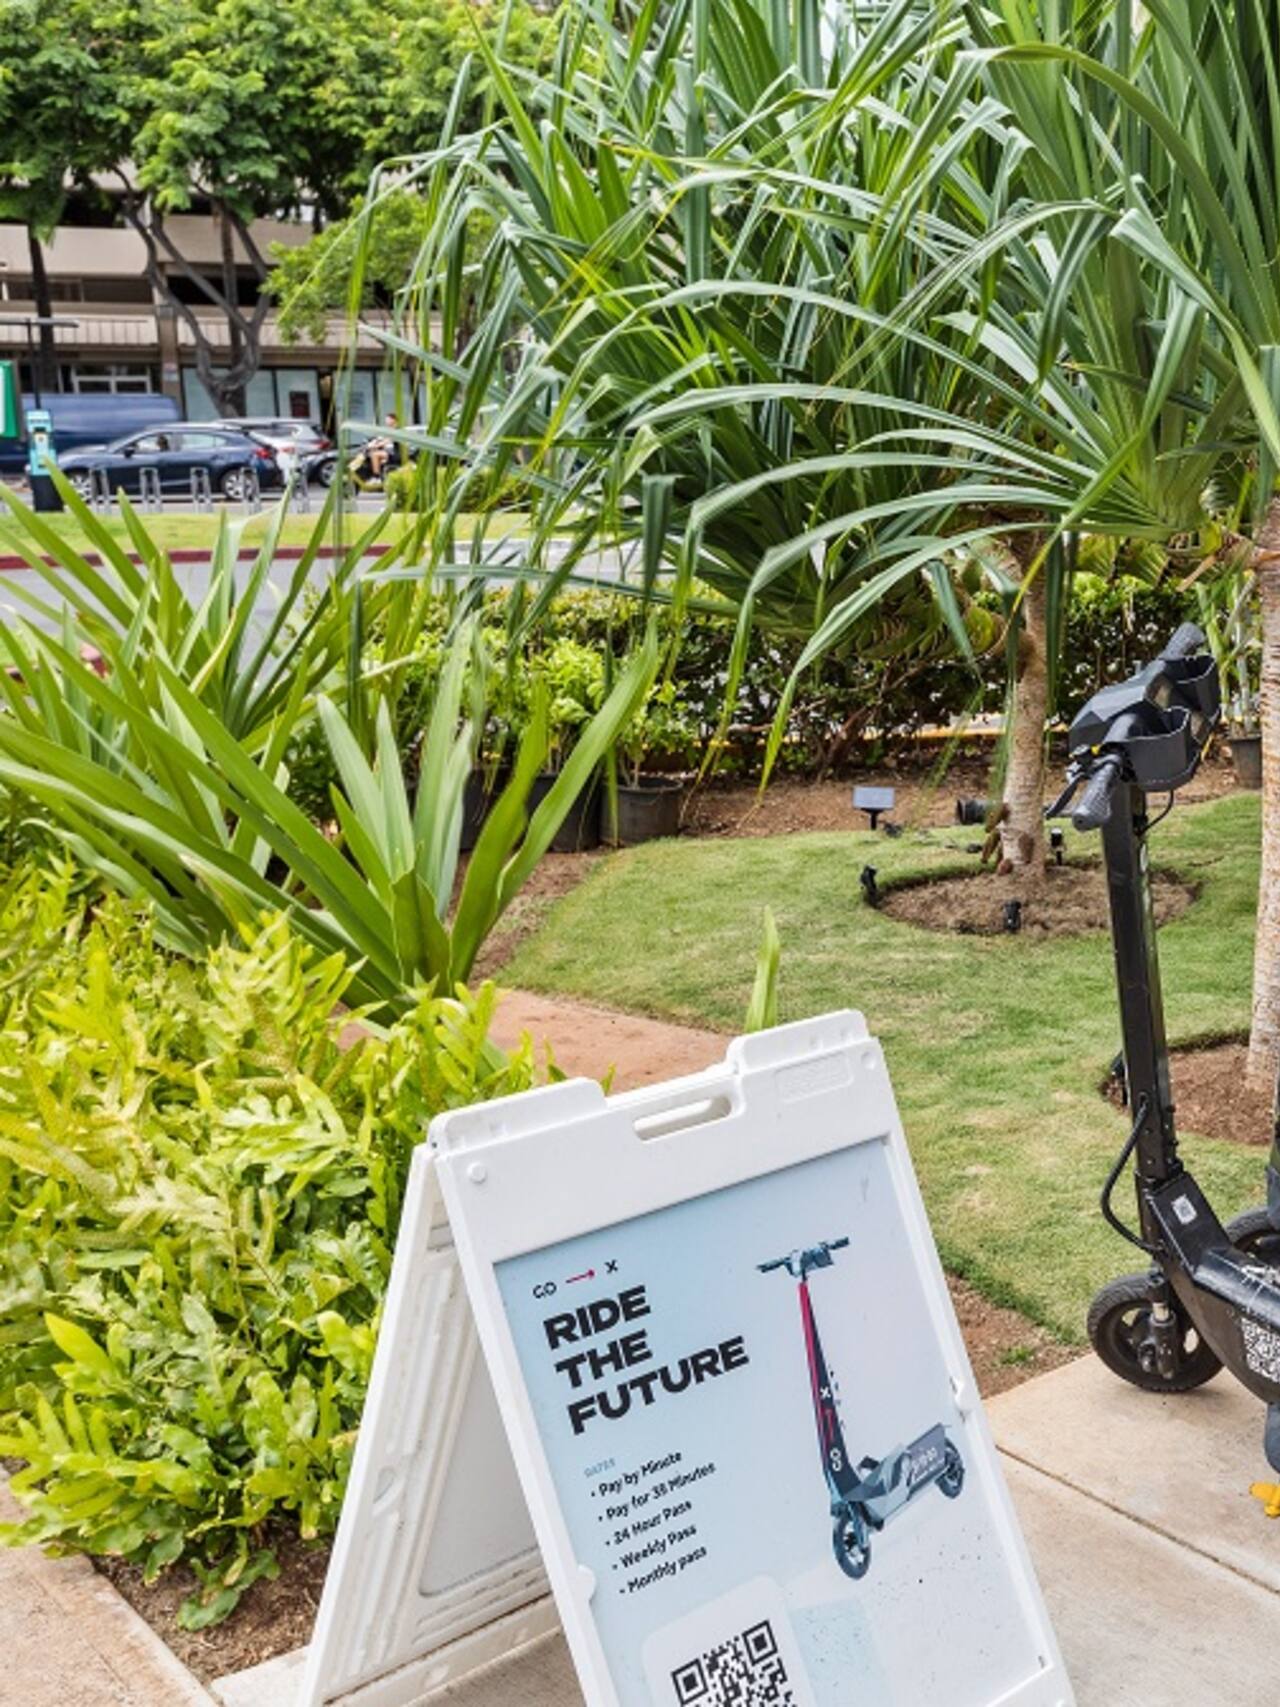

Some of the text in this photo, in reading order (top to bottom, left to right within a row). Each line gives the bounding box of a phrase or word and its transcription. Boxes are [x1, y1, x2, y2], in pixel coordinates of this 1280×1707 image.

[532, 1259, 619, 1299] GO X
[543, 1285, 651, 1350] RIDE
[554, 1329, 653, 1388] THE
[567, 1335, 750, 1435] FUTURE
[599, 1452, 682, 1497] Pay by Minute
[606, 1503, 629, 1520] Pay
[632, 1493, 650, 1508] for
[667, 1463, 716, 1492] Minutes
[614, 1501, 692, 1545] 24 Hour Pass
[619, 1524, 697, 1568] Weekly Pass
[627, 1546, 707, 1593] Monthly pass
